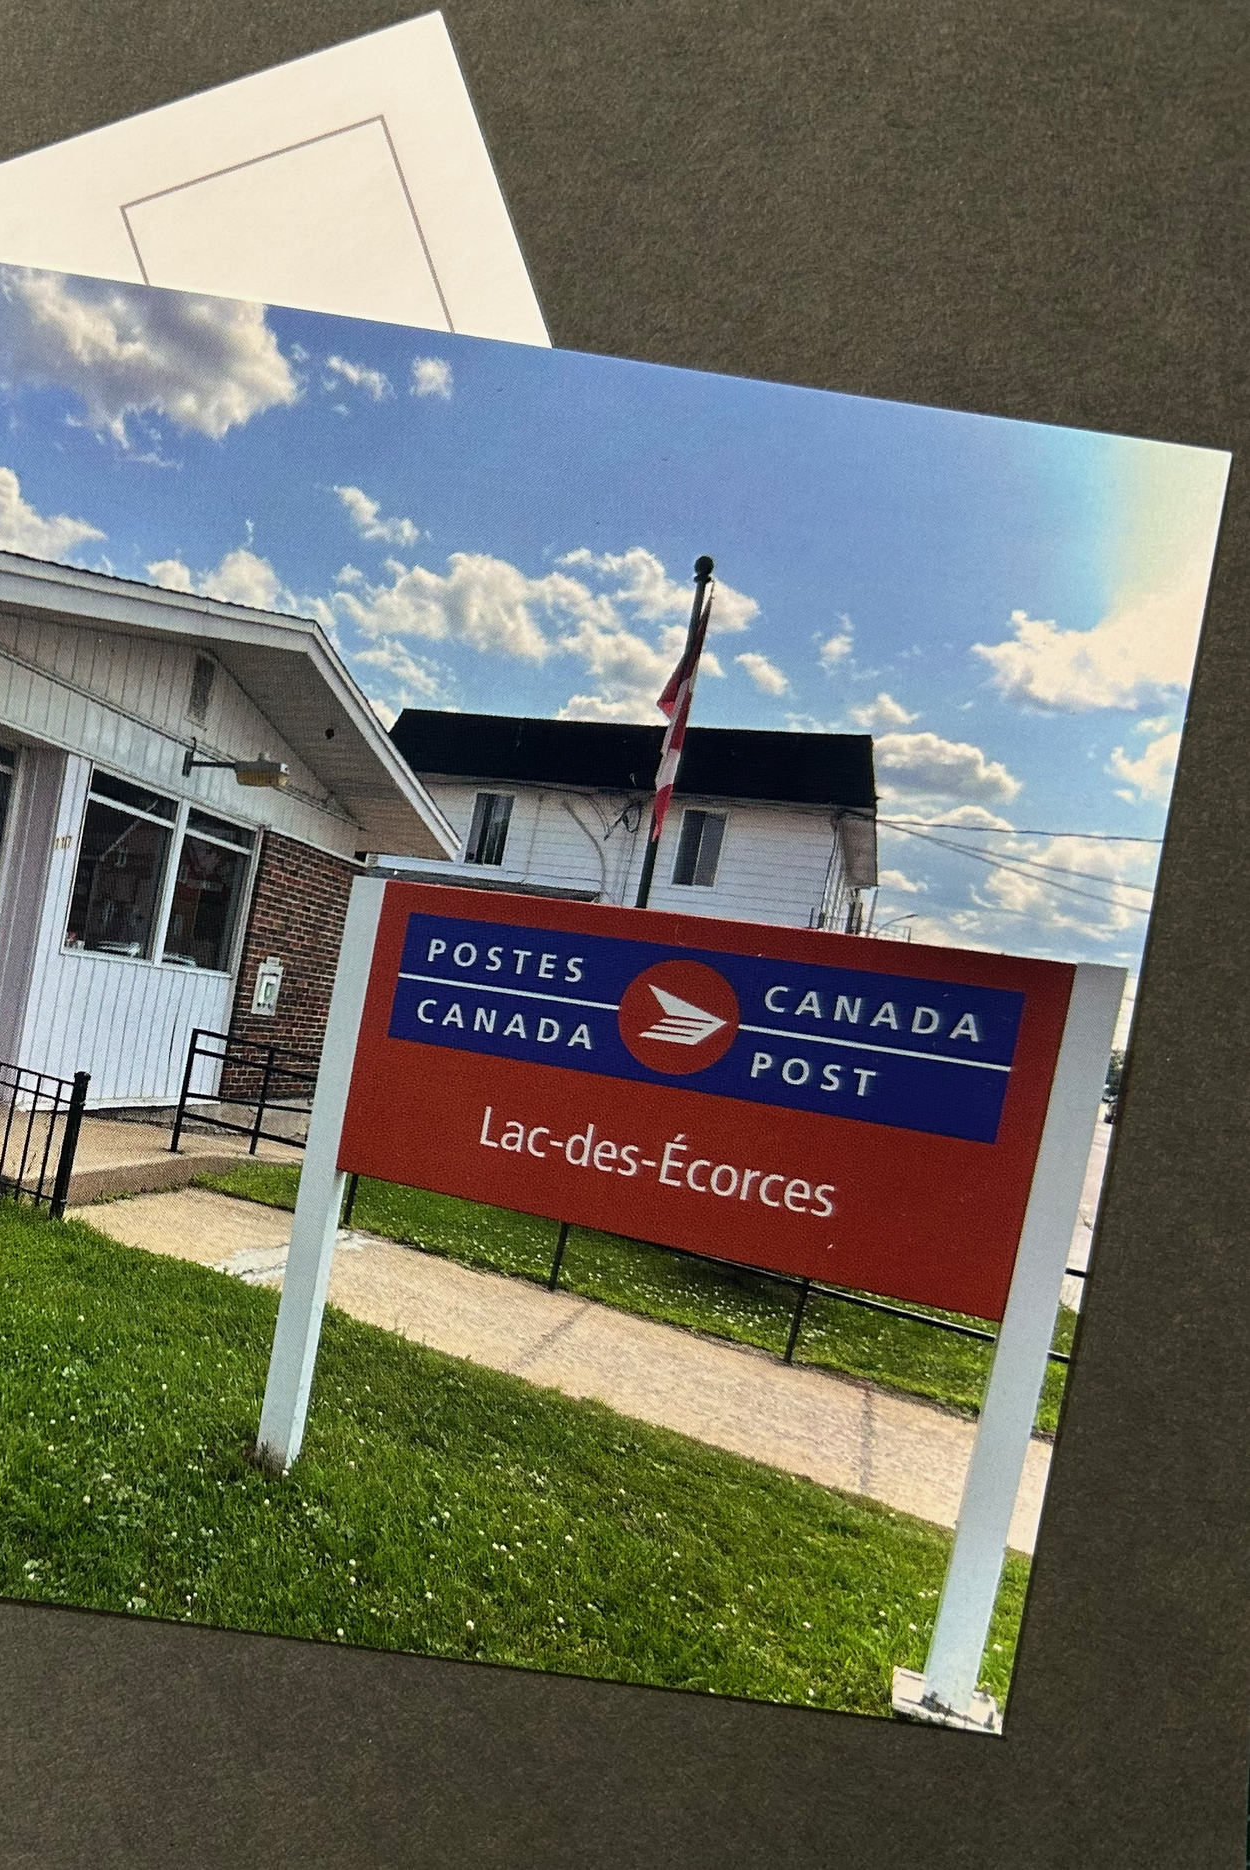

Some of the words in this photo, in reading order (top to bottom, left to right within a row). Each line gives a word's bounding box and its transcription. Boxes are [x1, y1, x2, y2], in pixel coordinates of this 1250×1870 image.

[427, 938, 585, 983] POSTES
[417, 999, 593, 1050] CANADA
[764, 985, 981, 1043] CANADA
[750, 1052, 878, 1097] POST
[479, 1105, 836, 1218] Lac-des-Écorces
